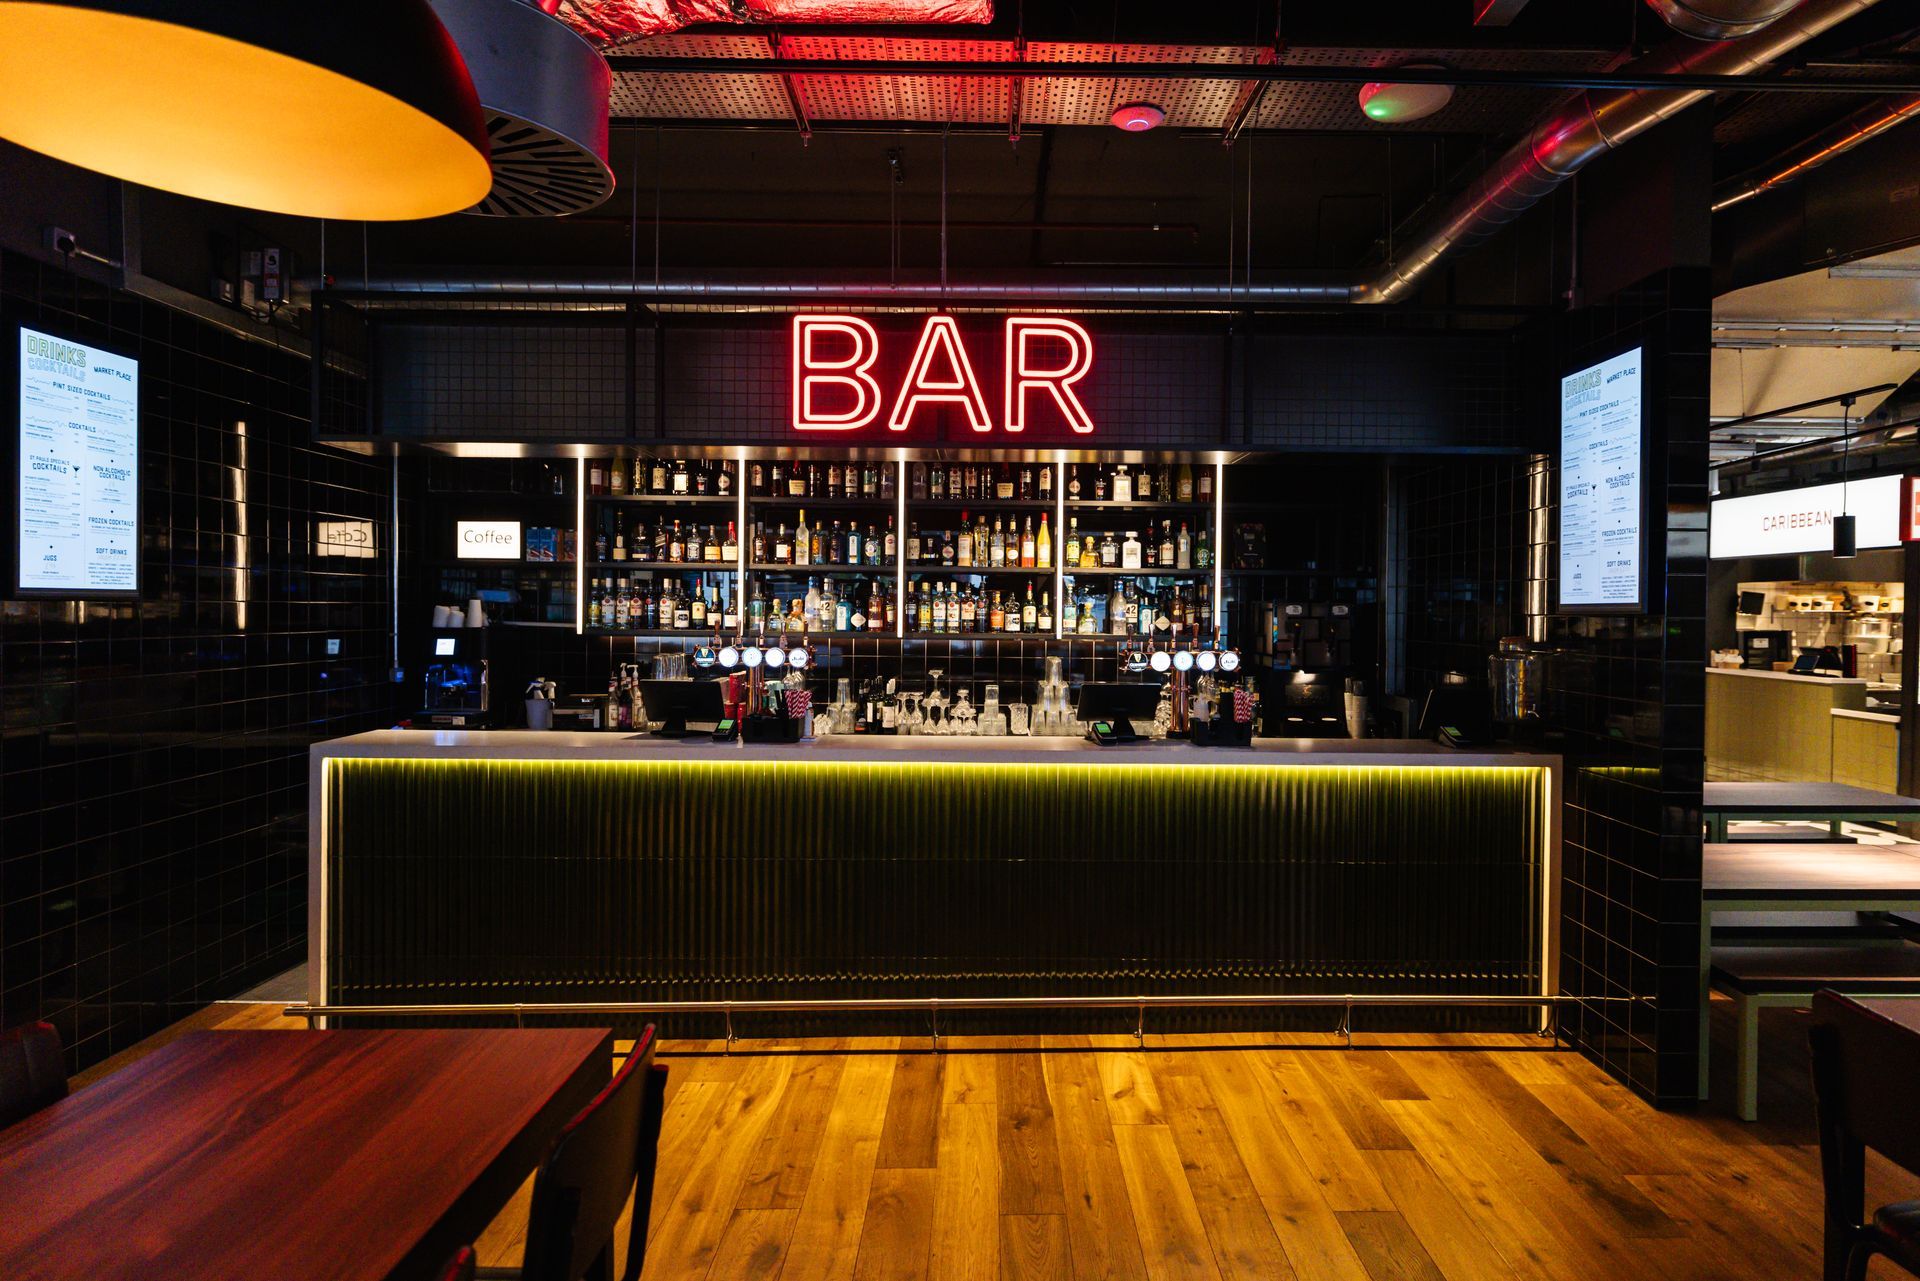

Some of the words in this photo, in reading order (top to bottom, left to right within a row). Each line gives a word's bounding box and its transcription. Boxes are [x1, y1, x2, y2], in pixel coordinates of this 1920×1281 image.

[27, 334, 86, 368] DRINKS
[28, 357, 86, 382] COCKTAILS
[93, 366, 115, 376] MARKET
[116, 370, 132, 382] PLACE
[792, 315, 1094, 433] BAR
[1606, 371, 1622, 384] MARKET
[1623, 367, 1636, 376] PLACE
[52, 381, 65, 390] PINT
[67, 385, 83, 394] SIZED
[83, 389, 111, 401] COCKTAILS
[68, 422, 97, 433] COCKTAILS
[32, 462, 68, 474] COCKTAILS
[104, 466, 131, 477] ALCOHOLIC
[99, 472, 126, 481] COCKTAILS
[88, 516, 108, 525] FROZEN
[108, 518, 134, 527] COCKTAILS
[1763, 509, 1832, 531] CARIBBEAN
[464, 529, 513, 544] Coffee
[95, 547, 109, 555] SOFT
[110, 548, 127, 556] DRINKS
[1125, 605, 1136, 615] 42
